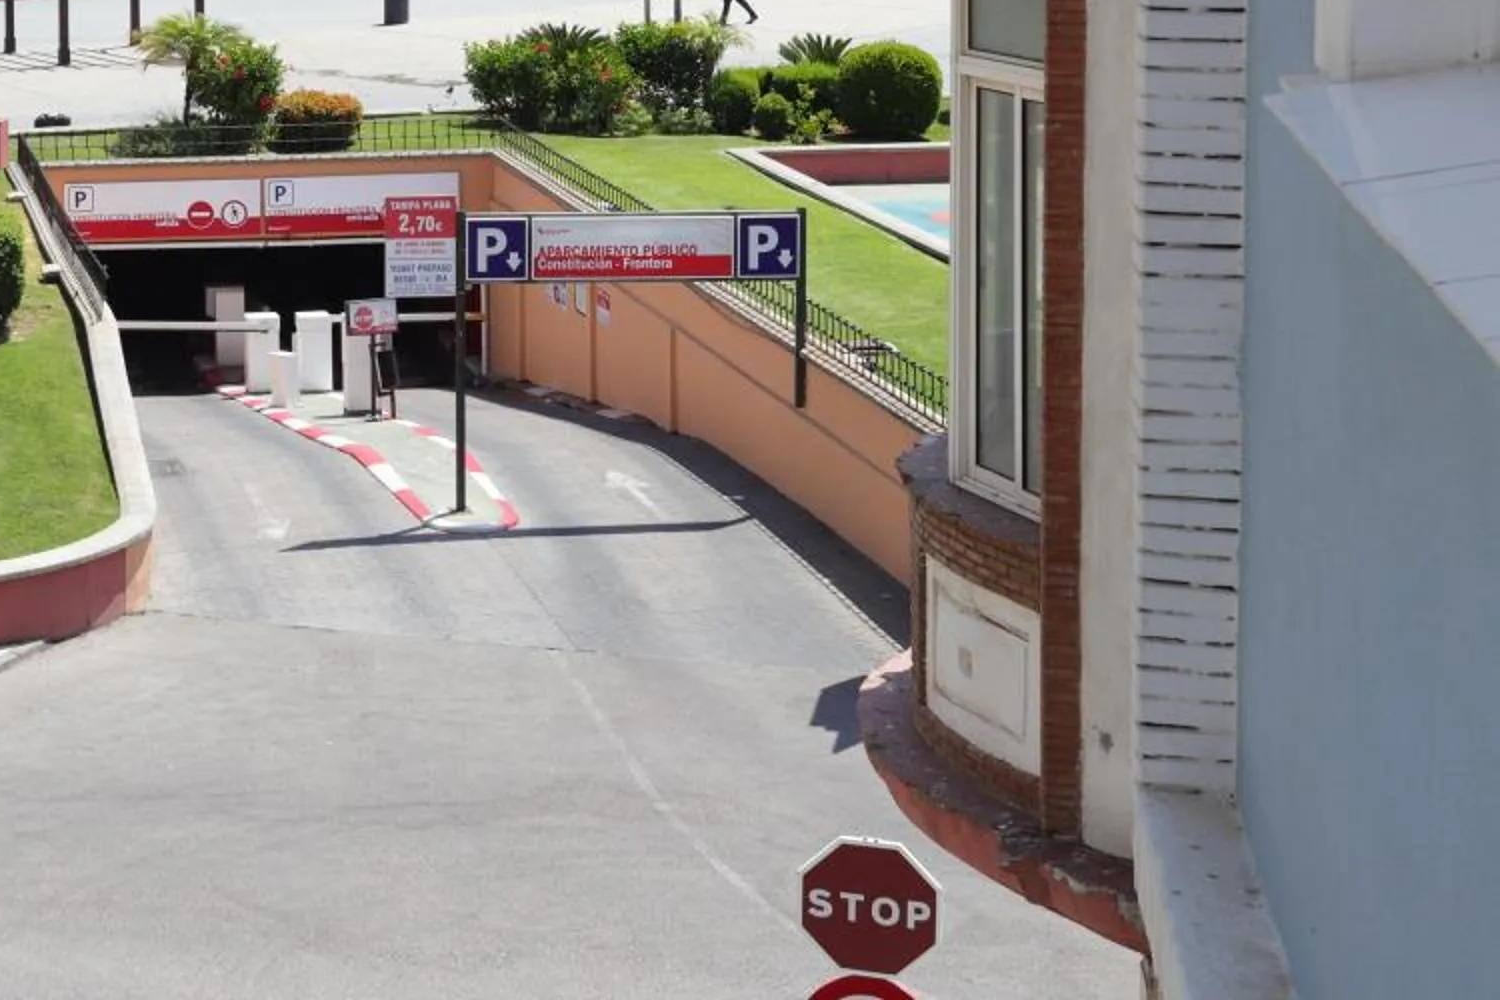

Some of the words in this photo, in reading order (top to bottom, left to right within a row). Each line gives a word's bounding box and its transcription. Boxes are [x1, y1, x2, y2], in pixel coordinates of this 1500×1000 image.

[75, 191, 87, 208] P
[275, 186, 287, 202] P
[476, 227, 508, 273] P
[536, 245, 639, 257] APARCAMIENTO
[747, 225, 779, 270] P
[623, 258, 673, 269] Frontera
[808, 888, 931, 930] STOP
